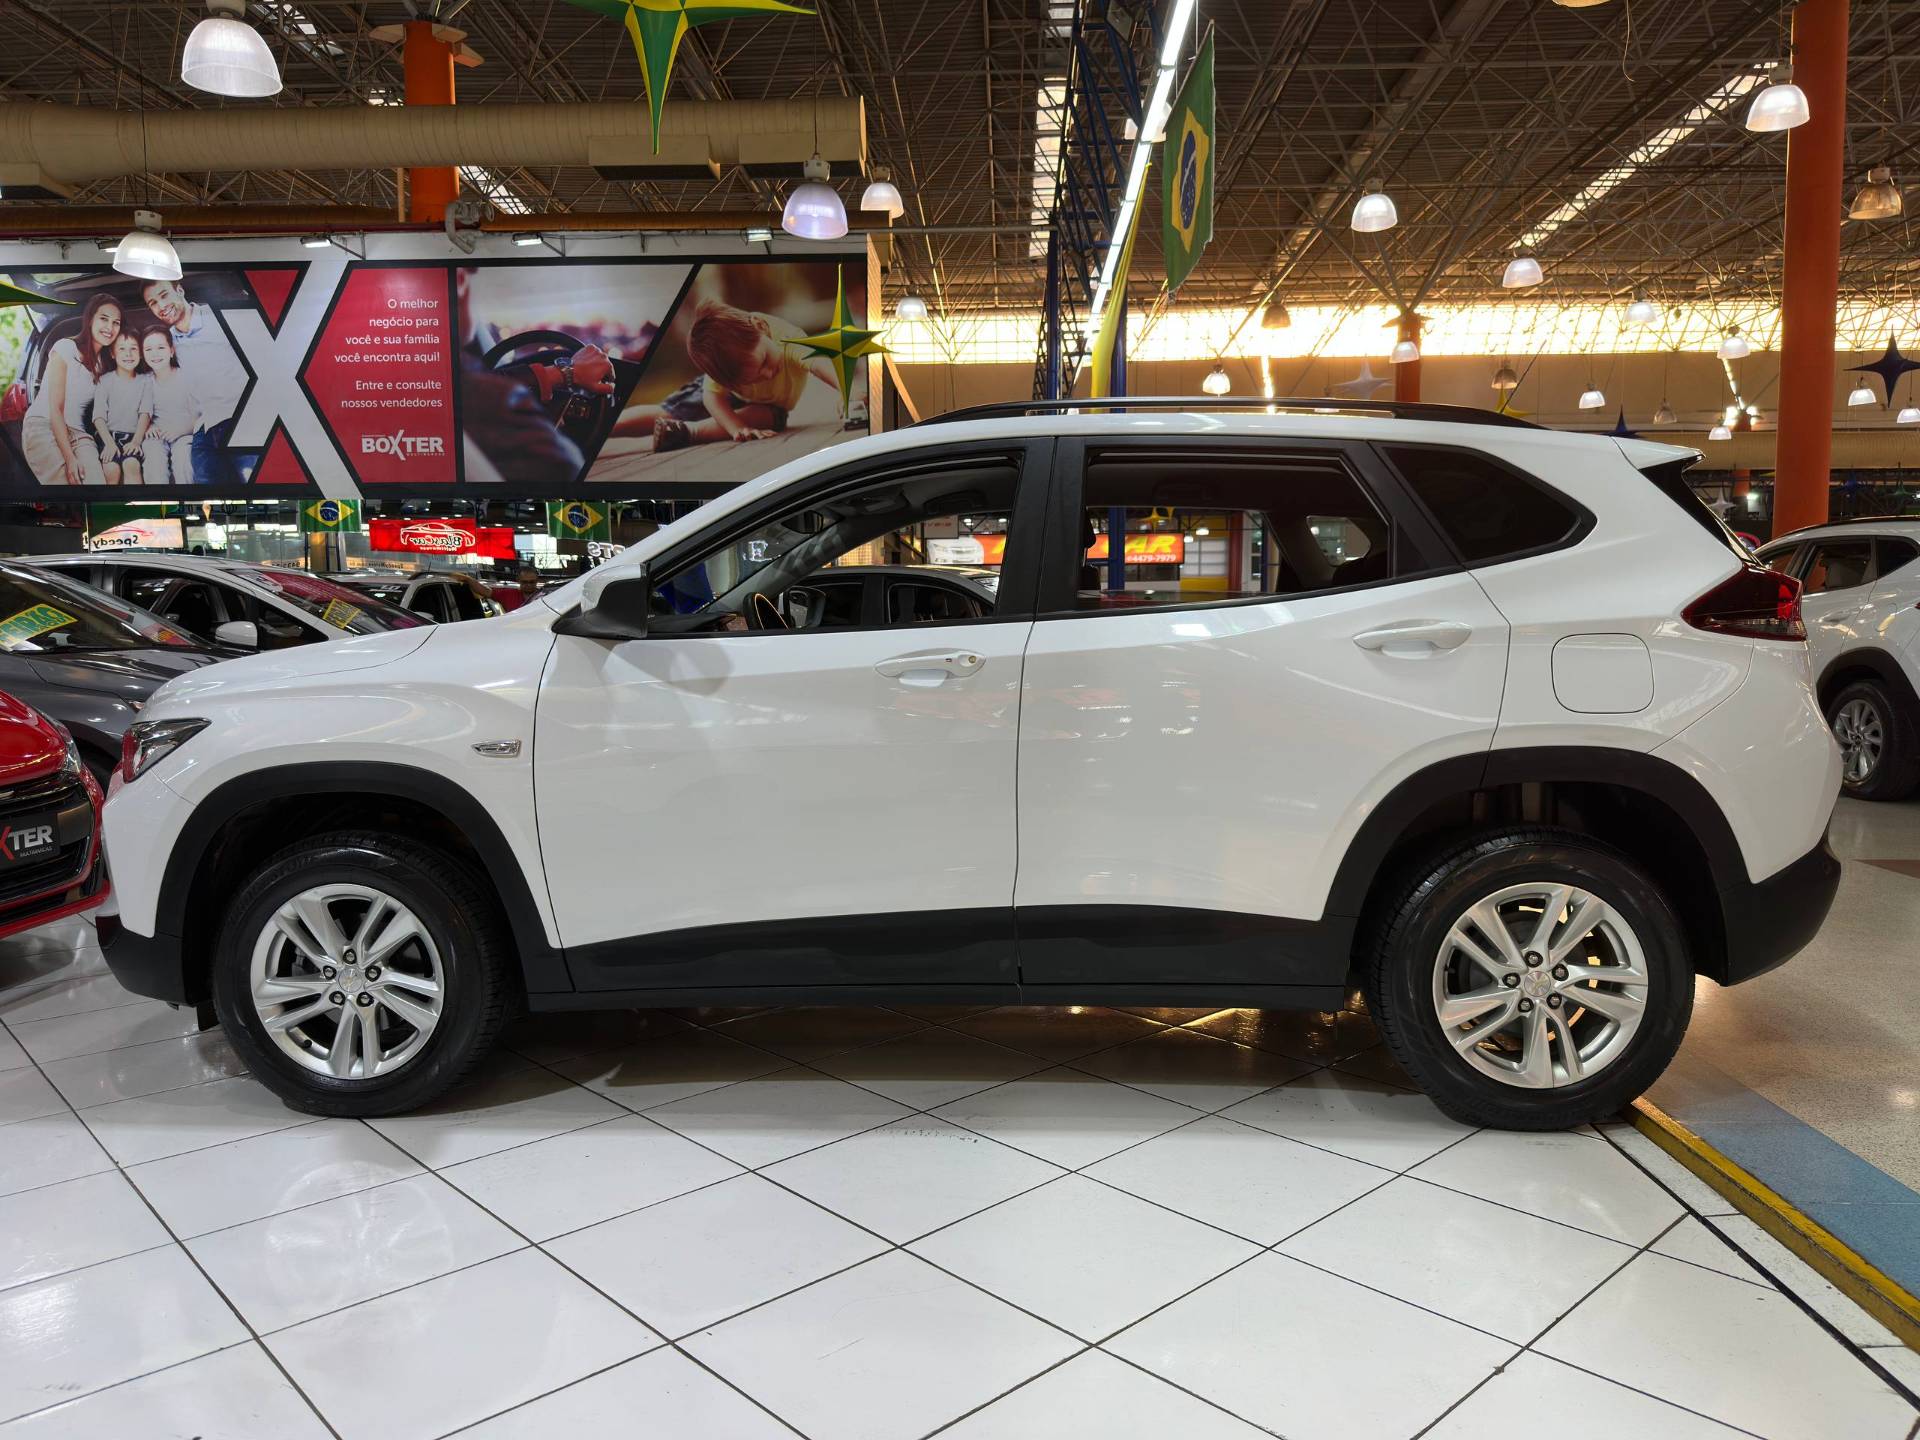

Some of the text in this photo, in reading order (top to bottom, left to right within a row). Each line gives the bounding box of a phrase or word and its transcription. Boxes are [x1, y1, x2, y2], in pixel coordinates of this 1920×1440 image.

[387, 298, 439, 309] O melhor
[369, 317, 439, 329] negócio para
[345, 334, 440, 345] você e sua família
[334, 352, 440, 364] você encontra aqui!
[355, 380, 442, 390] Entre e consulte
[341, 398, 443, 408] nossos vendedores
[361, 429, 445, 461] BOXTER
